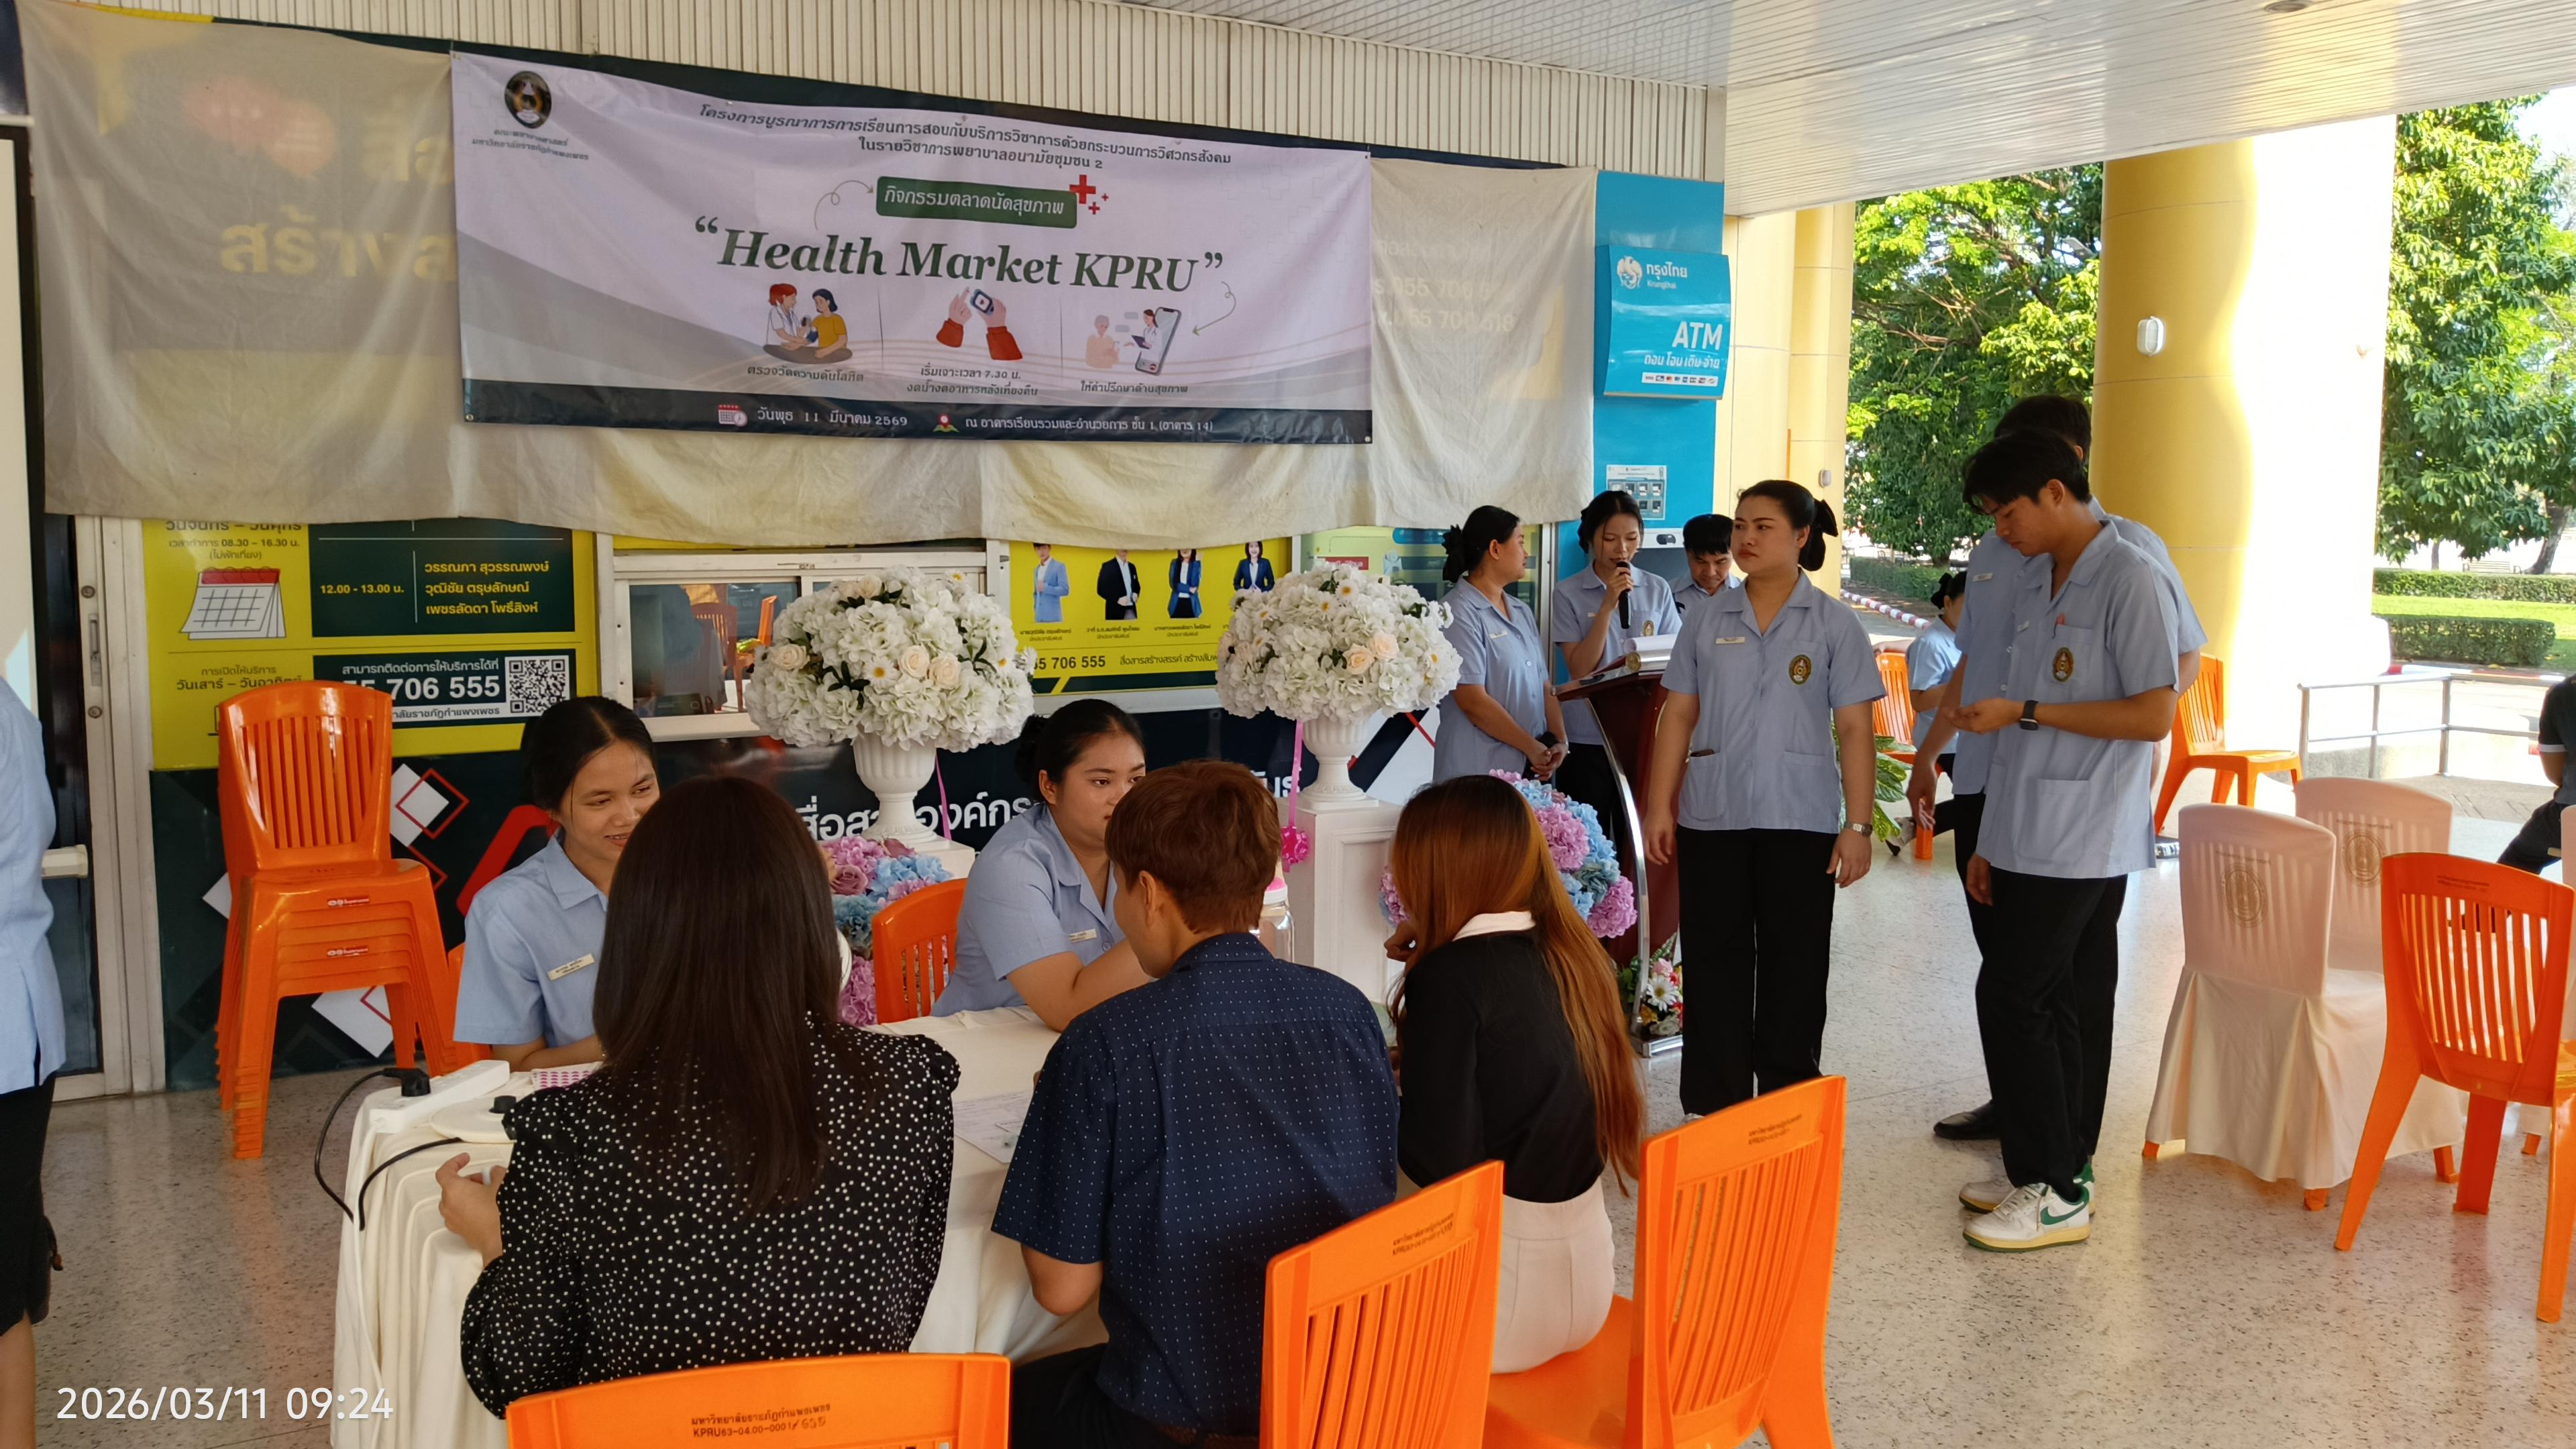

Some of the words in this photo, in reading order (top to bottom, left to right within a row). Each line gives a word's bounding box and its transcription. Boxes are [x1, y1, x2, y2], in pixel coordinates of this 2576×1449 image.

[859, 136, 1090, 169] ในรายวิชาการพยาบาลอนามัยชุมชน
[1095, 159, 1104, 170] 2
[883, 184, 1065, 219] กิจกรรมตลาดนัดสุขภาพ
[896, 241, 1063, 286] Market
[1070, 251, 1224, 293] KPRU”
[1646, 262, 1688, 280] กรุงไทย
[1671, 321, 1723, 351] ATM
[1644, 354, 1665, 366] ถอน
[1666, 352, 1683, 366] โอน
[747, 365, 865, 382] ตรวจวัดความดันโลหิต
[920, 362, 981, 378] เริ่มเจาะเวลา
[984, 370, 1008, 380] 7.30
[1011, 371, 1021, 380] น.
[907, 380, 1038, 396] งดน้ำงดอาหารหลังเที่ยงคืน
[1081, 380, 1189, 395] ให้คำปรึกษาด้านสุขภาพ
[757, 407, 794, 425] วันพุธ
[829, 409, 871, 425] มีนาคม
[875, 415, 908, 426] 2569
[965, 419, 977, 428] ณ
[981, 417, 1128, 430] อาคารเรียนรวมและอำนวยการ
[1132, 415, 1145, 430] ชั้น
[1159, 421, 1193, 431] (อาคาร
[221, 538, 249, 547] 08.30
[261, 538, 288, 547] 16.30
[290, 539, 301, 547] น.
[209, 549, 262, 560] (ไม่พักเที่ยง)
[480, 560, 549, 576] สุวรรณพงษ์
[320, 584, 351, 594] 12.00
[361, 584, 390, 594] 13.00
[393, 584, 405, 594] น.
[425, 581, 464, 596] วุฒิชัย
[467, 580, 530, 596] ตรุษลักษณ์
[426, 602, 488, 615] เพชรลัดดา
[201, 664, 277, 676] การเปิดให้บริการ
[342, 657, 499, 675] สามารถติดต่อการให้บริการได้ที่
[1051, 656, 1077, 669] 706
[1081, 655, 1106, 668] 555
[176, 677, 224, 691] วันเสาร์
[386, 677, 439, 700] 706
[449, 675, 500, 699] 555
